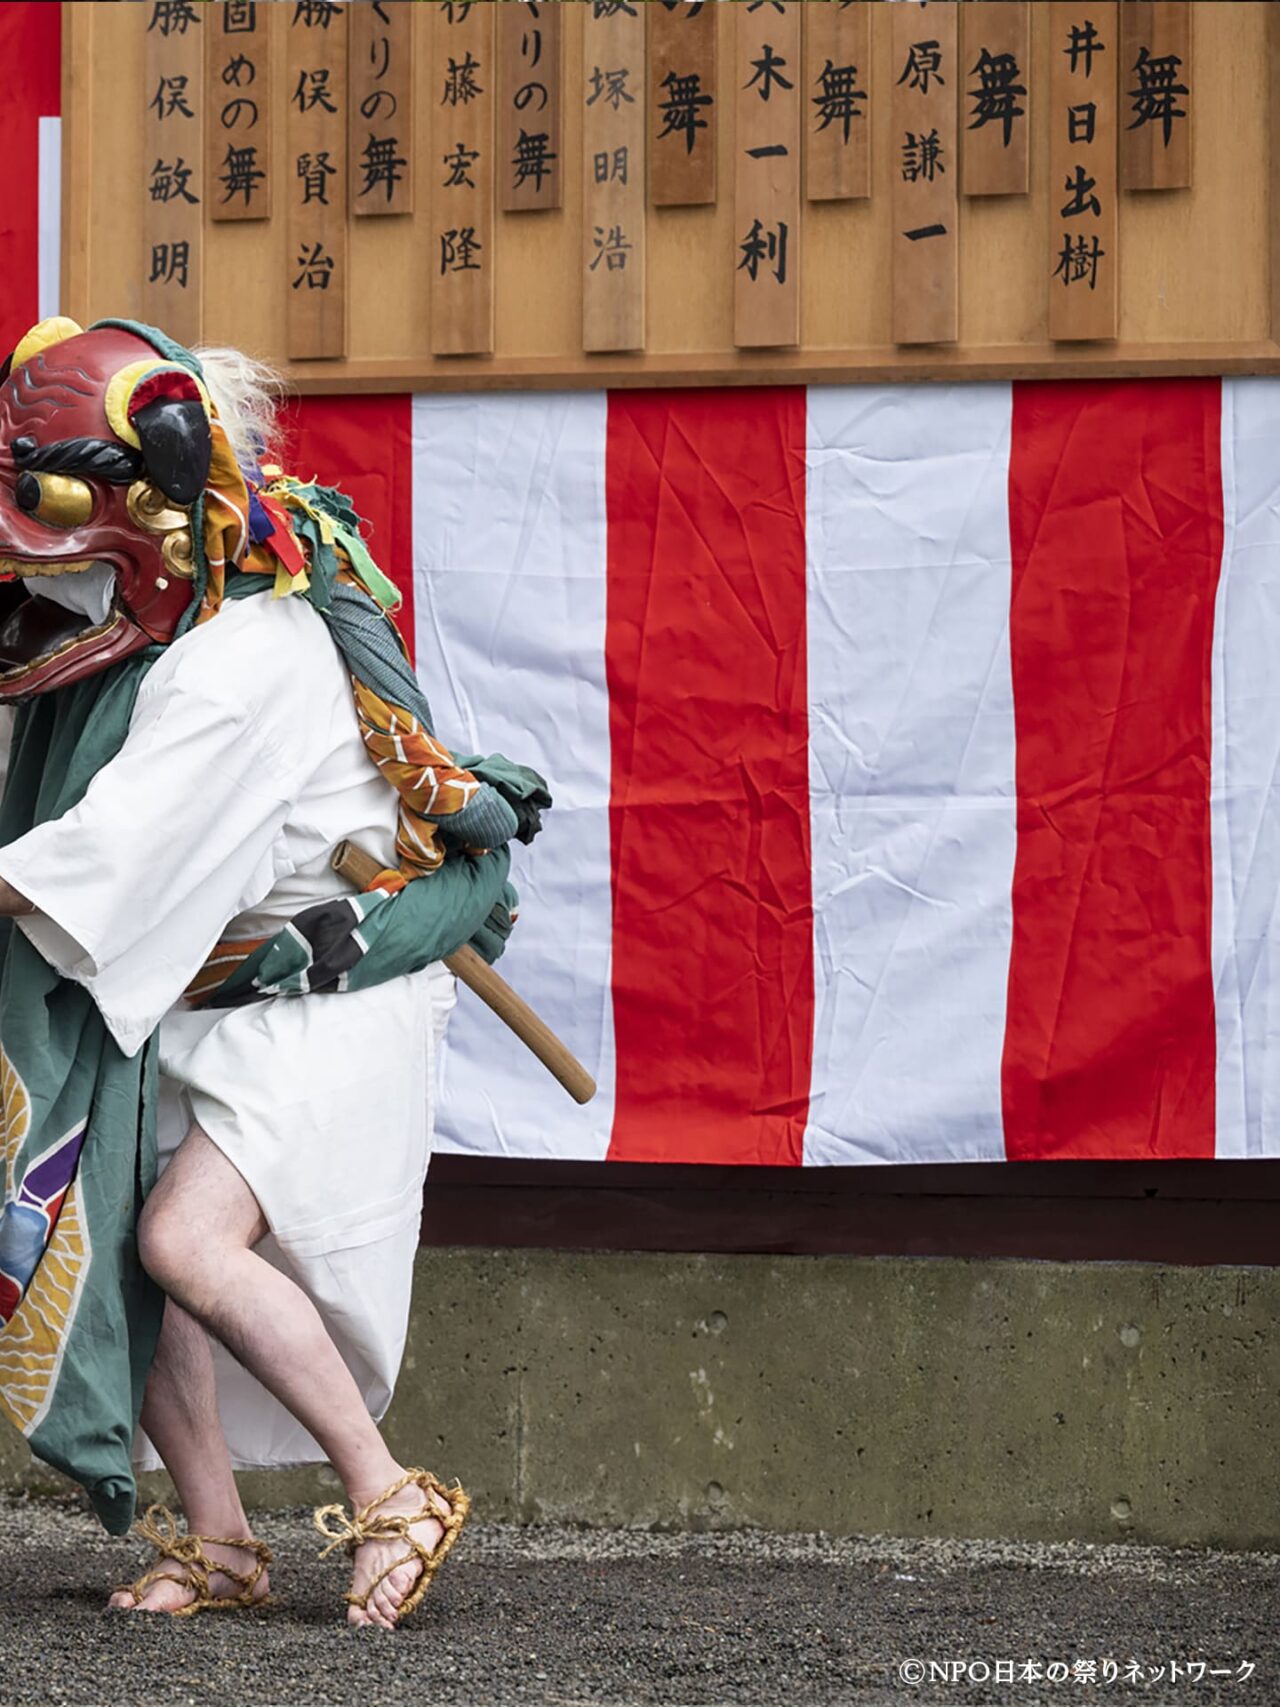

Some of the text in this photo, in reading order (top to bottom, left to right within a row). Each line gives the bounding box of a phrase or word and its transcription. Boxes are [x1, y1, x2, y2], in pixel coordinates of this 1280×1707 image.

[736, 2, 794, 285] 木一利
[895, 2, 948, 242] 原謙一
